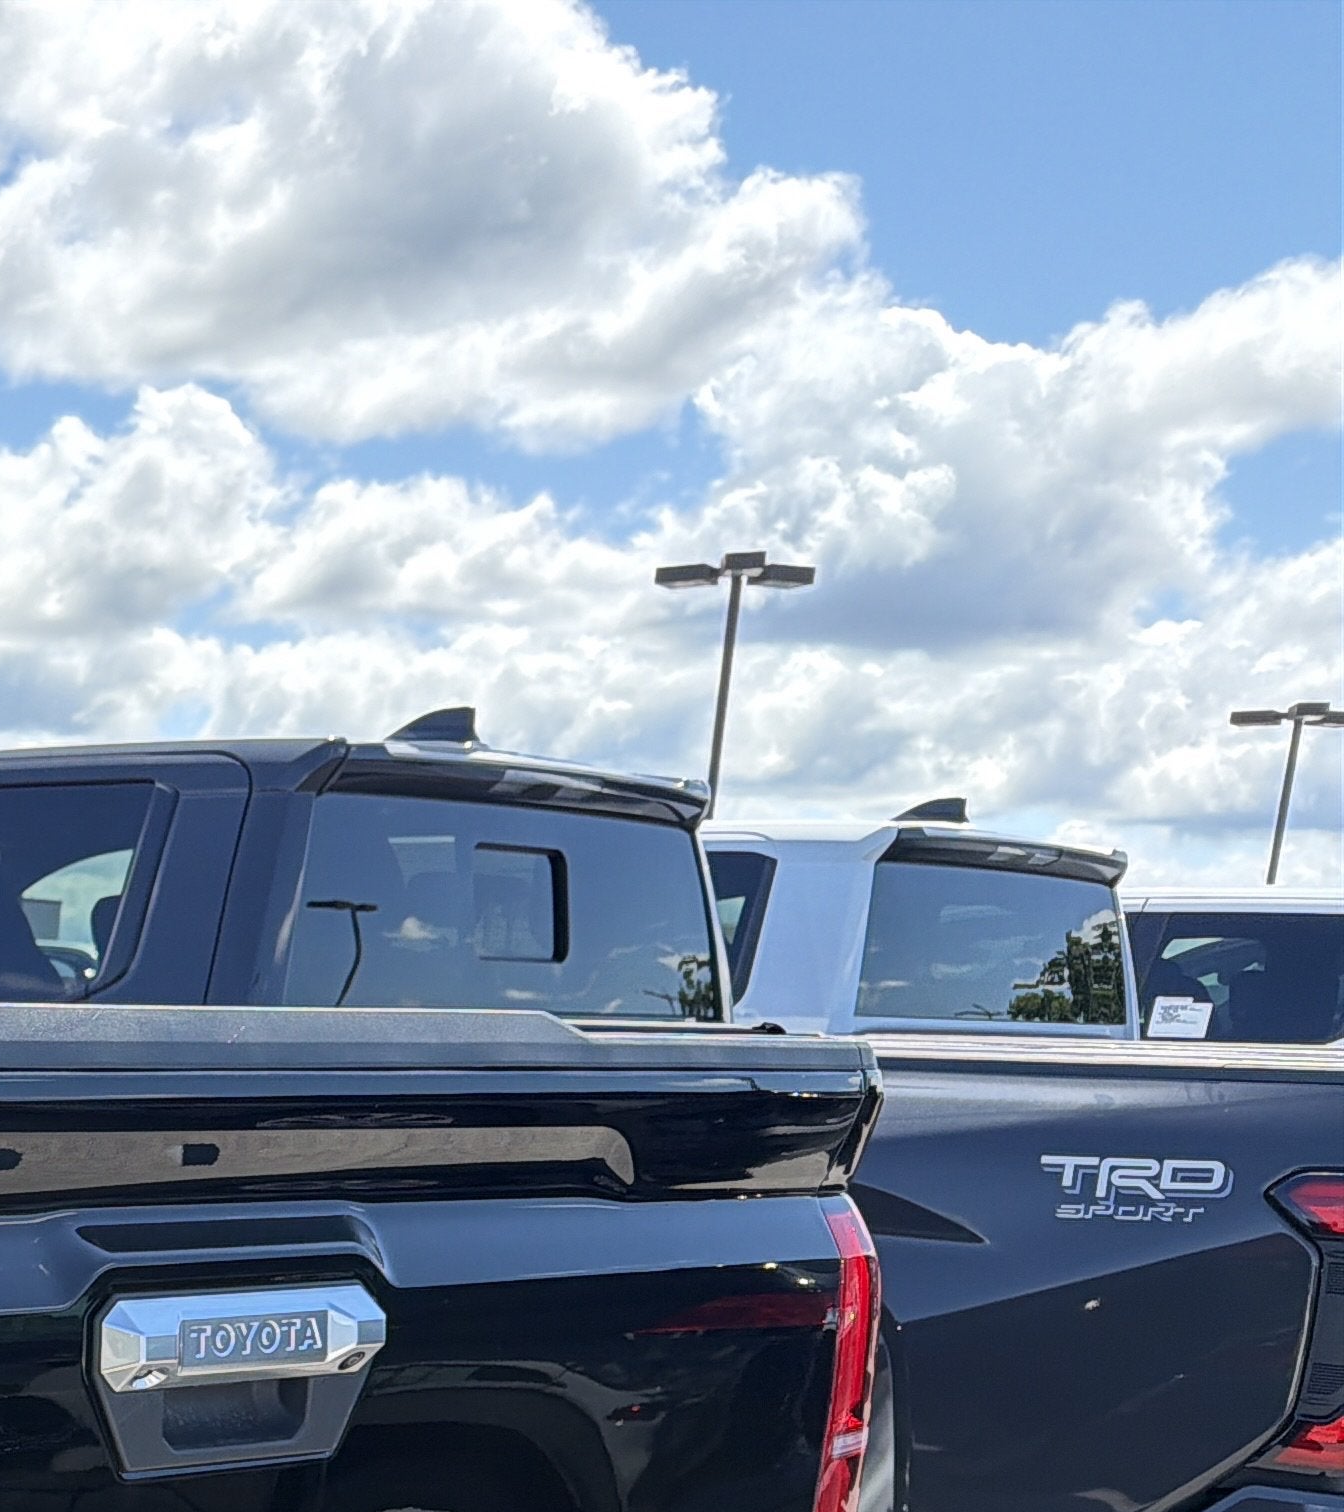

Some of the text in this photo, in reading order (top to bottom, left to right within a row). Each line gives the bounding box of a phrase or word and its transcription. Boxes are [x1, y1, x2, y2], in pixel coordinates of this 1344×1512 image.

[1041, 1154, 1226, 1200] TRD
[1055, 1202, 1204, 1223] SPORT
[189, 1317, 323, 1360] TOYOTA
